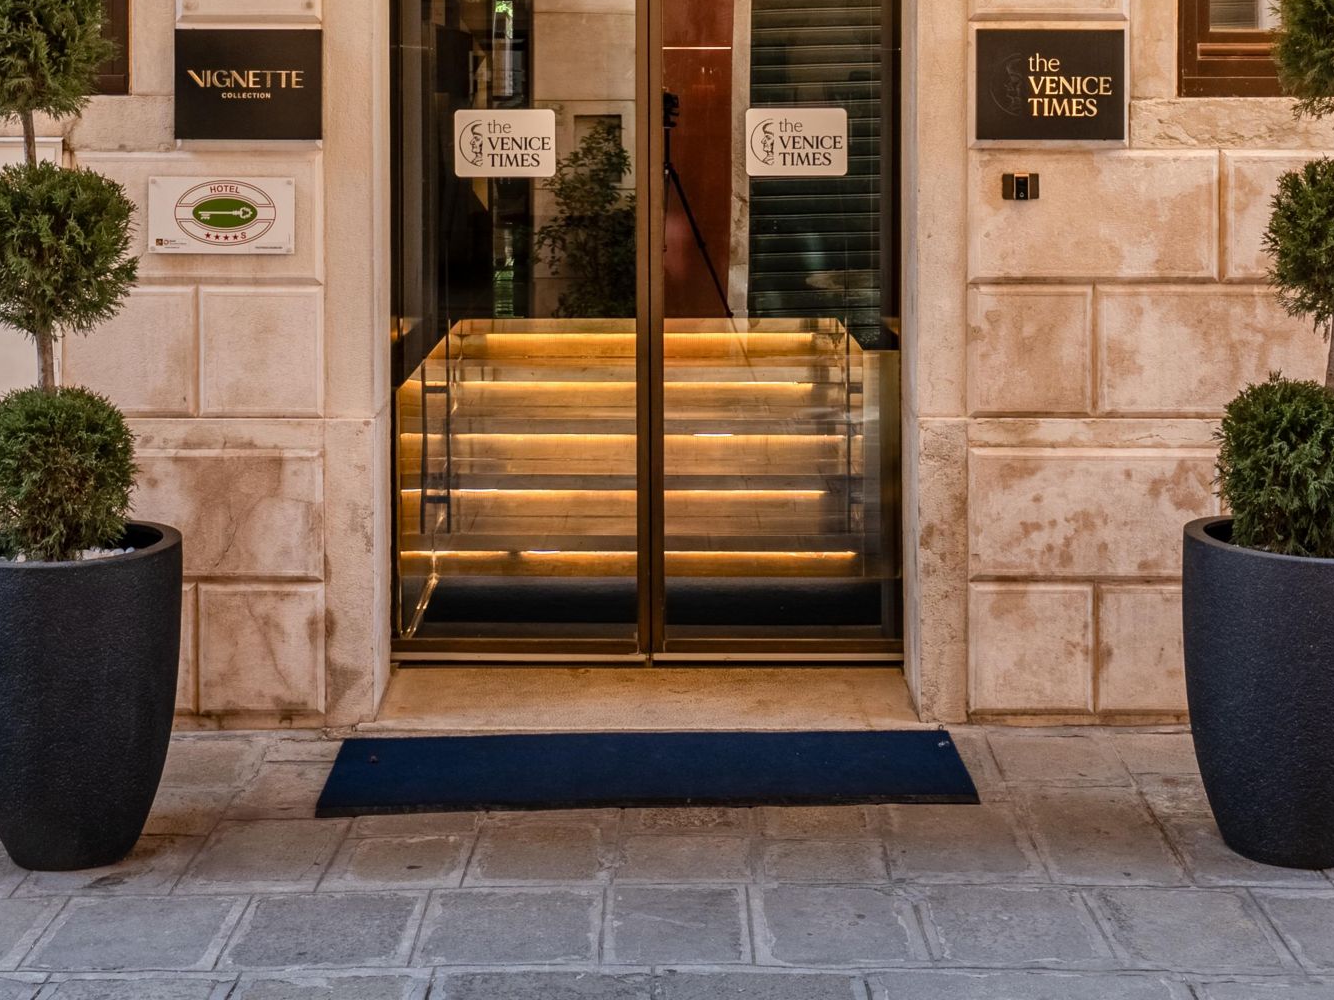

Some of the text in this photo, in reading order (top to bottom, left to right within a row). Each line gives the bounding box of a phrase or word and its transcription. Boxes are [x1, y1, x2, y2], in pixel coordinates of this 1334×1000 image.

[1028, 53, 1060, 72] the
[187, 70, 304, 88] VIGNETTE
[1028, 76, 1113, 96] VENICE
[1028, 98, 1098, 117] TIMES
[487, 120, 512, 134] the
[779, 118, 803, 132] the
[487, 137, 551, 151] VENICE
[779, 135, 843, 150] VENICE
[487, 153, 540, 167] TIMES
[779, 152, 832, 166] TIMES
[210, 185, 240, 194] HOTEL
